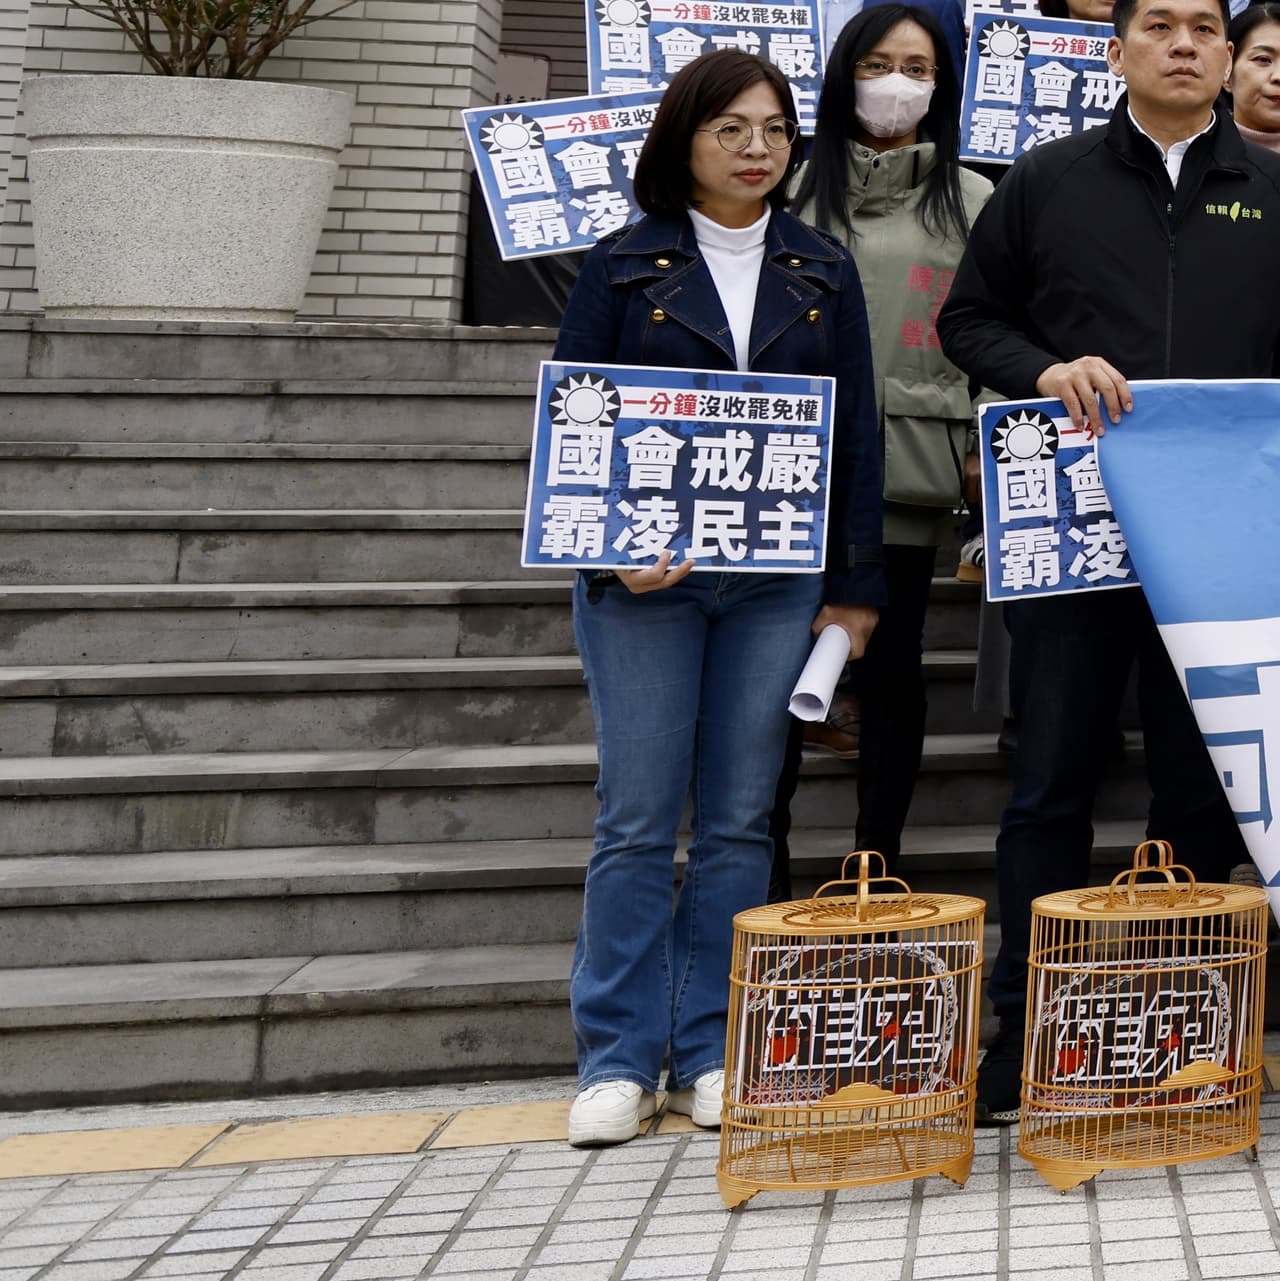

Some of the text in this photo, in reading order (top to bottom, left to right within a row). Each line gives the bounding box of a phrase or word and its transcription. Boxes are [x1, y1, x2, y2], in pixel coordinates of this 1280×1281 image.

[652, 3, 808, 26] 一分鐘沒收罷免權
[544, 107, 657, 134] 一分鐘沒收
[967, 107, 1111, 156] 霸凌
[623, 391, 820, 422] 一分鐘沒收罷免權
[546, 425, 822, 493] 國會戒嚴
[539, 494, 816, 562] 霸凌民主
[1000, 519, 1130, 590] 霸凌
